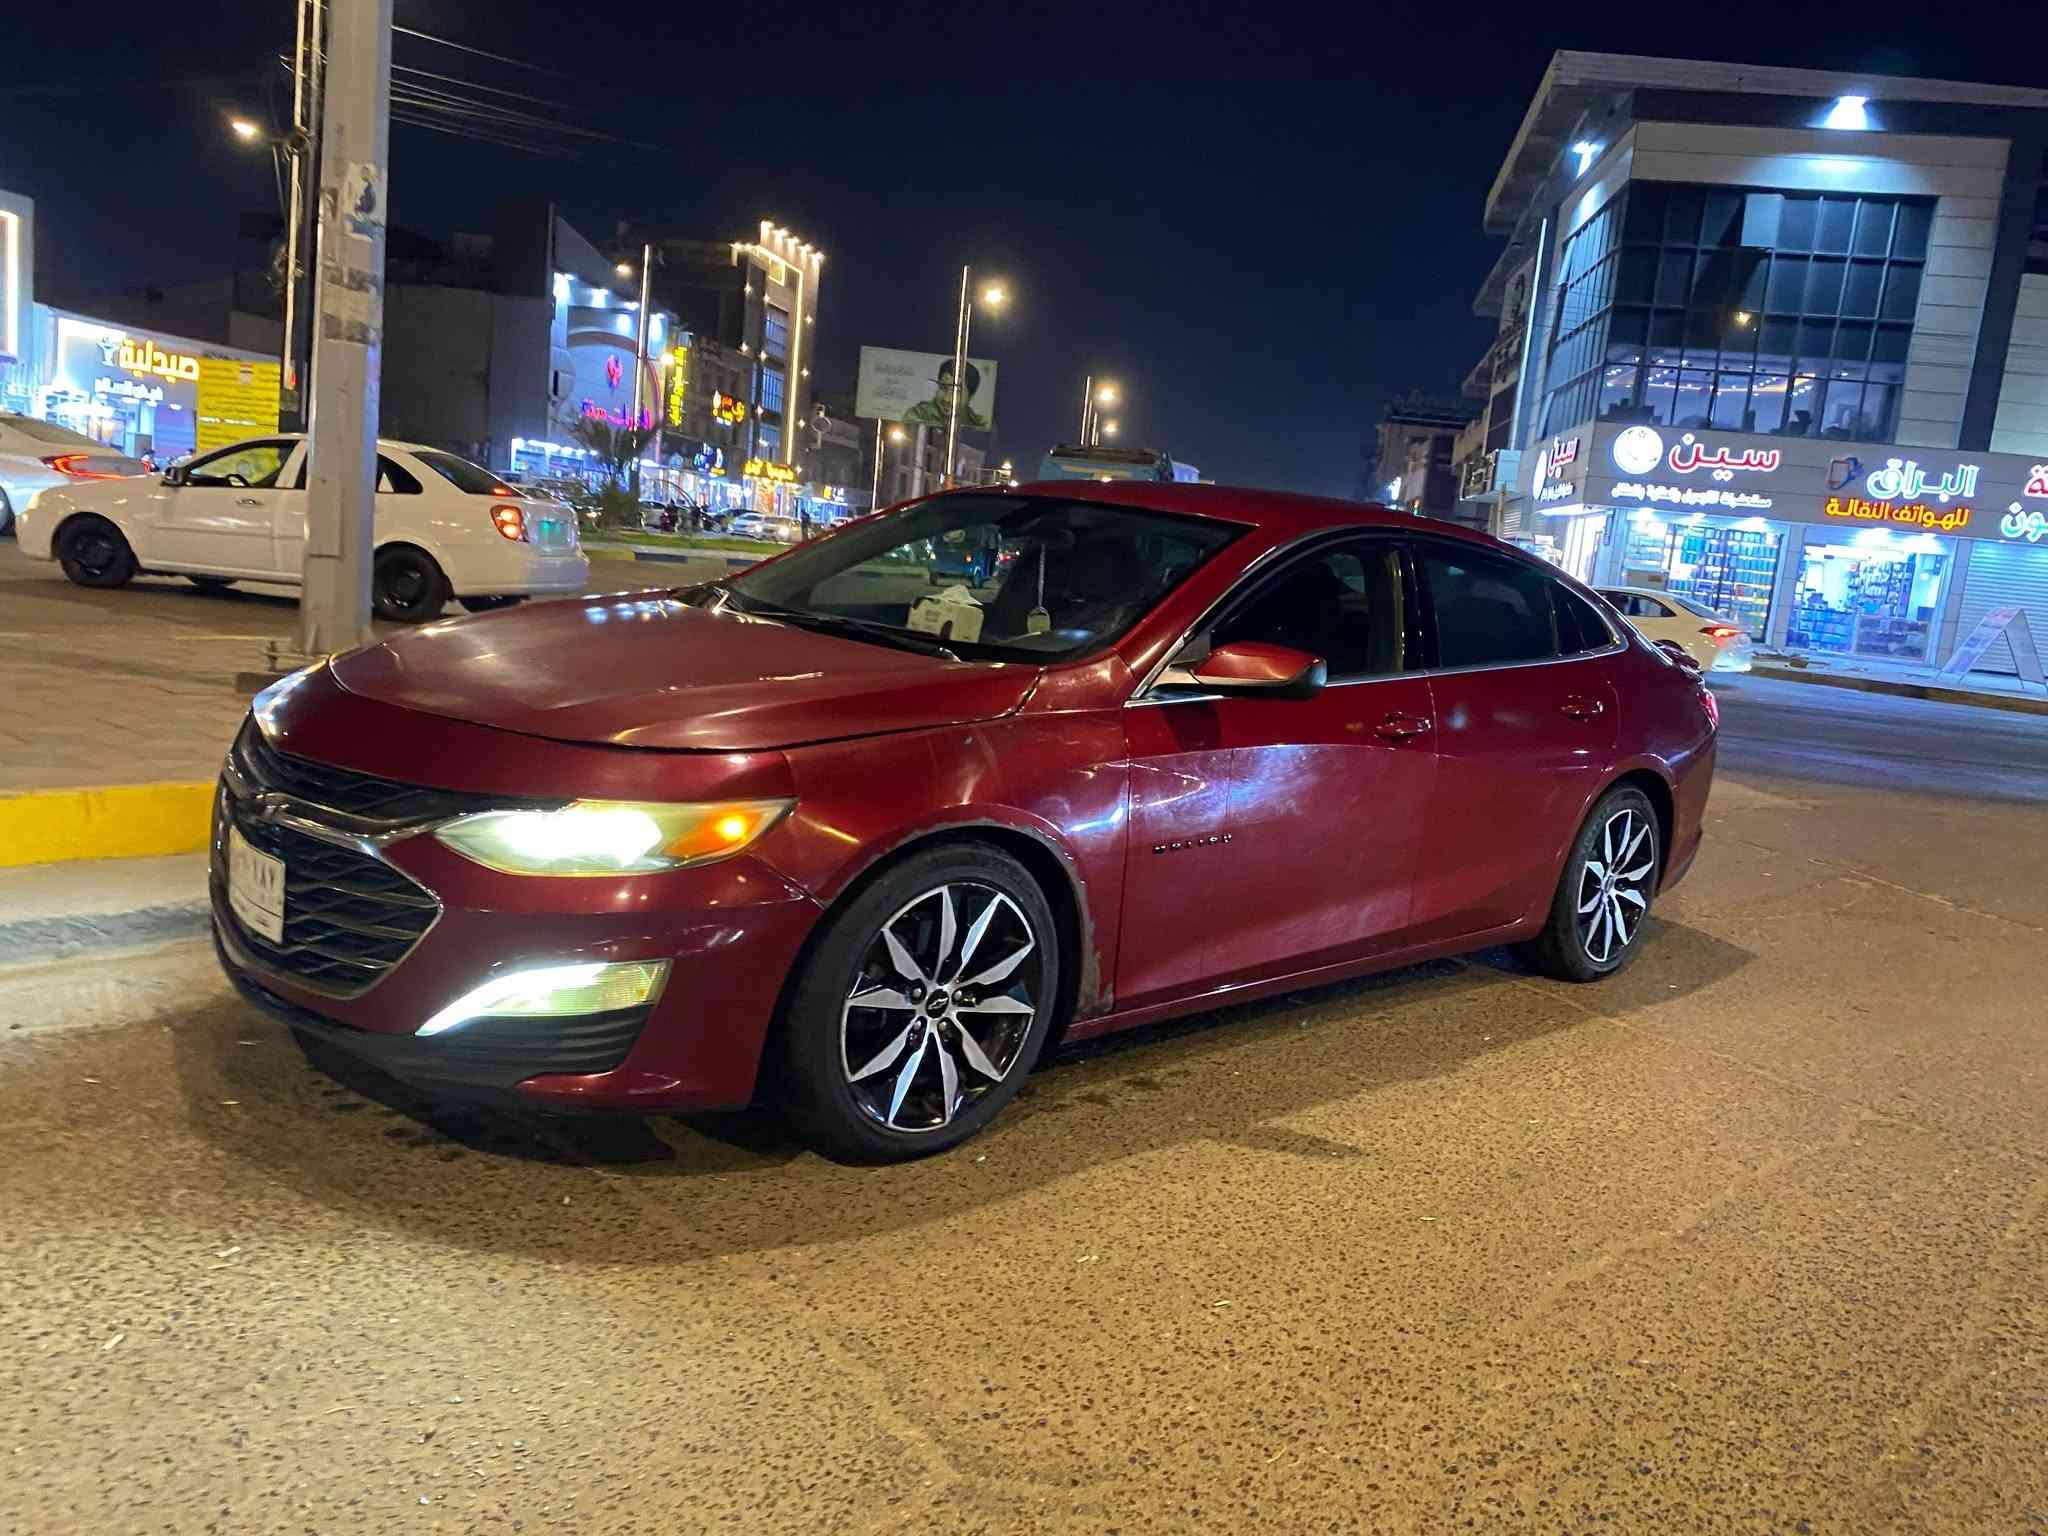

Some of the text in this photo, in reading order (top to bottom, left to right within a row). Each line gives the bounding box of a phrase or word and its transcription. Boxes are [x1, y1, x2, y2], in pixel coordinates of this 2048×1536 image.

[118, 337, 200, 384] صيدلية
[1668, 432, 1780, 481] سين
[1866, 457, 1981, 503] البراق
[1824, 495, 1970, 530] للهواتف النقالة
[2000, 501, 2048, 543] ون
